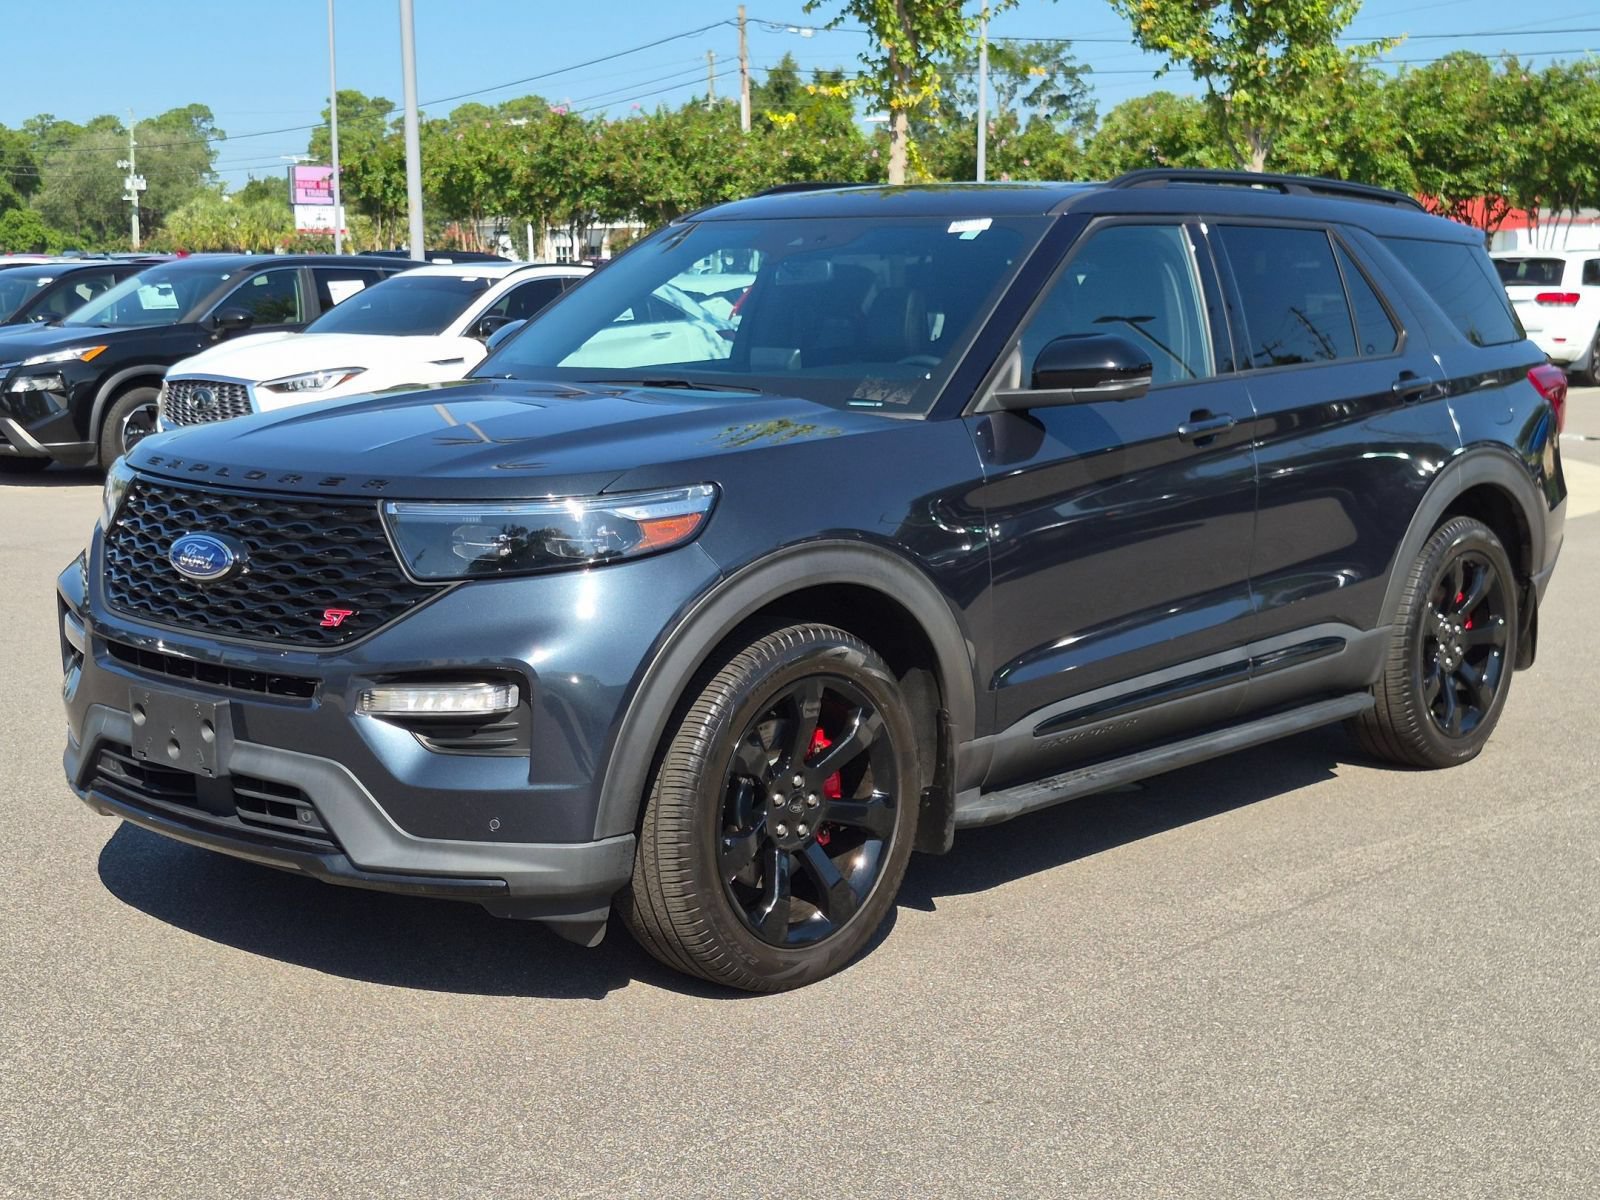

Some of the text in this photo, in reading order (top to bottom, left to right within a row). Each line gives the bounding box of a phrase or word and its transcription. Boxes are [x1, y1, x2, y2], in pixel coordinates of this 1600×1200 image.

[147, 456, 390, 491] EXPLORER
[179, 543, 215, 570] Ford
[320, 608, 352, 627] ST
